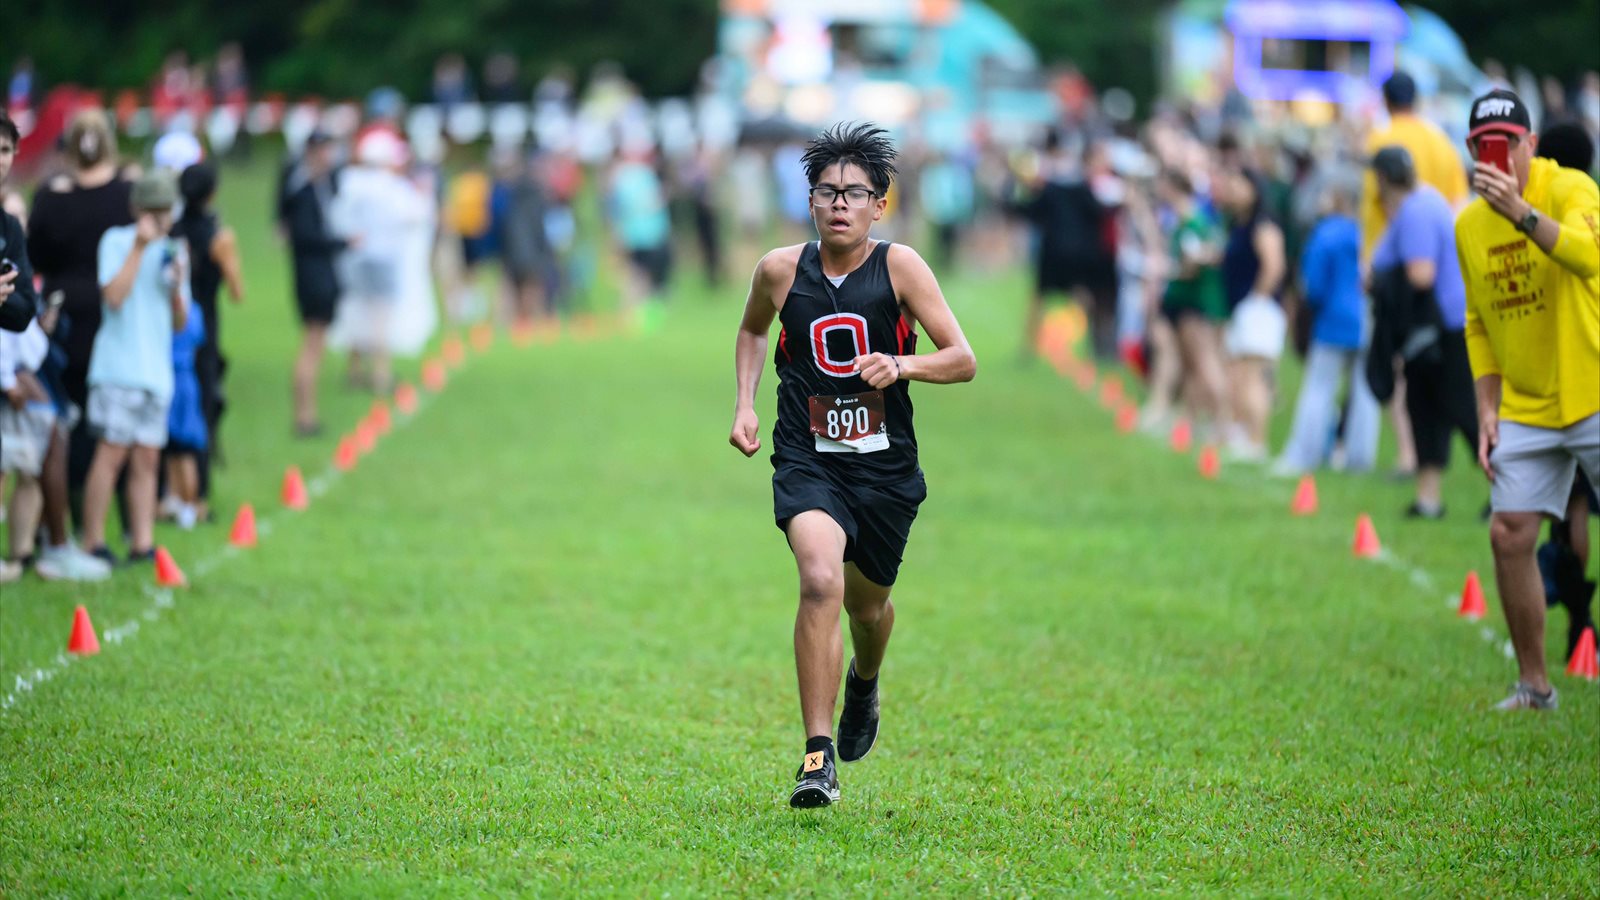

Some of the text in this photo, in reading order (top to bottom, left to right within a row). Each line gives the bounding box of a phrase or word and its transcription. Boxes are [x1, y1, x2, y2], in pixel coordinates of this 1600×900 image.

[810, 312, 870, 378] O
[827, 406, 869, 439] 890
[810, 756, 818, 767] X
